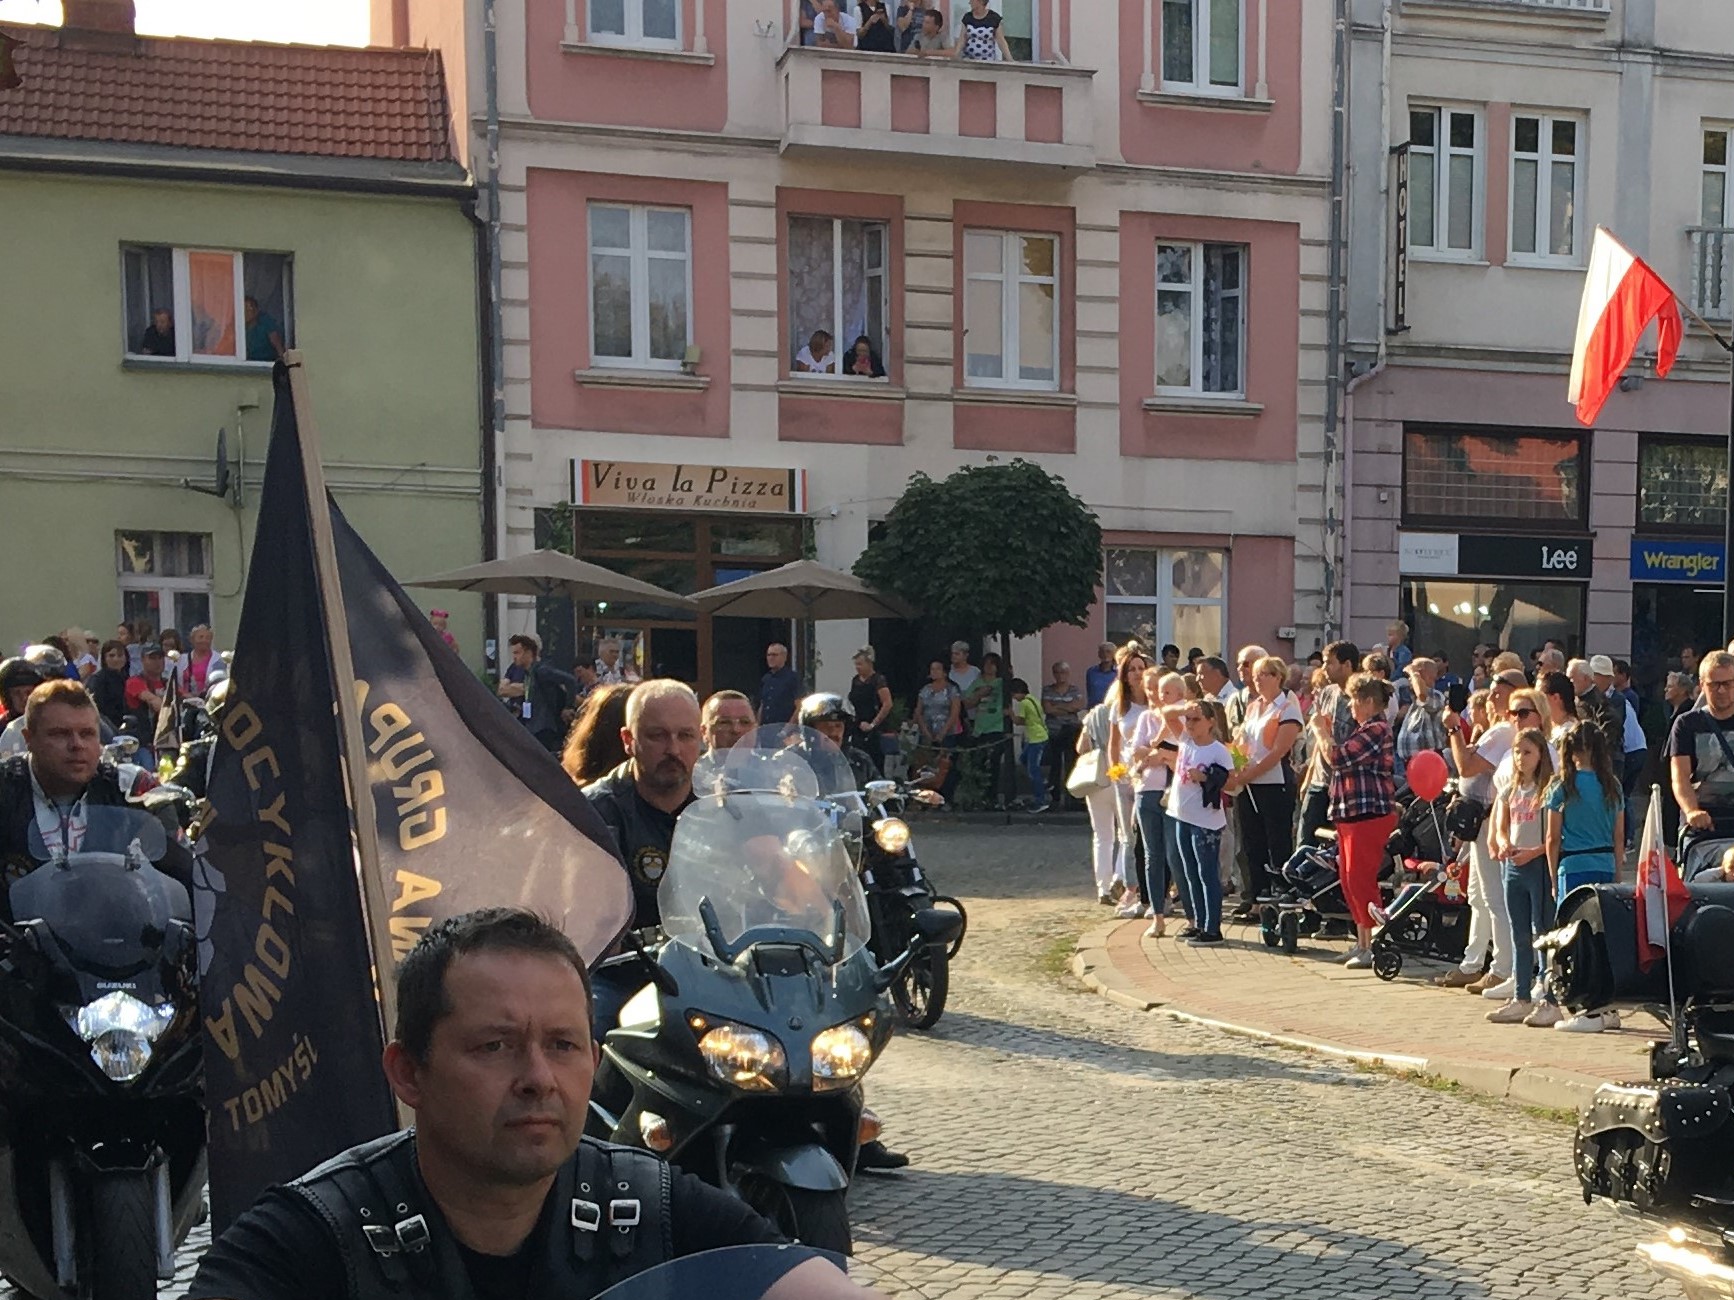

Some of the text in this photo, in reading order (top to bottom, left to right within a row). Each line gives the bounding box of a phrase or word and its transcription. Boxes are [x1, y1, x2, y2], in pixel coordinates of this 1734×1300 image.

[592, 463, 784, 497] Viva la Pizza
[1541, 546, 1578, 570] Lee
[1643, 551, 1720, 577] Wrangler
